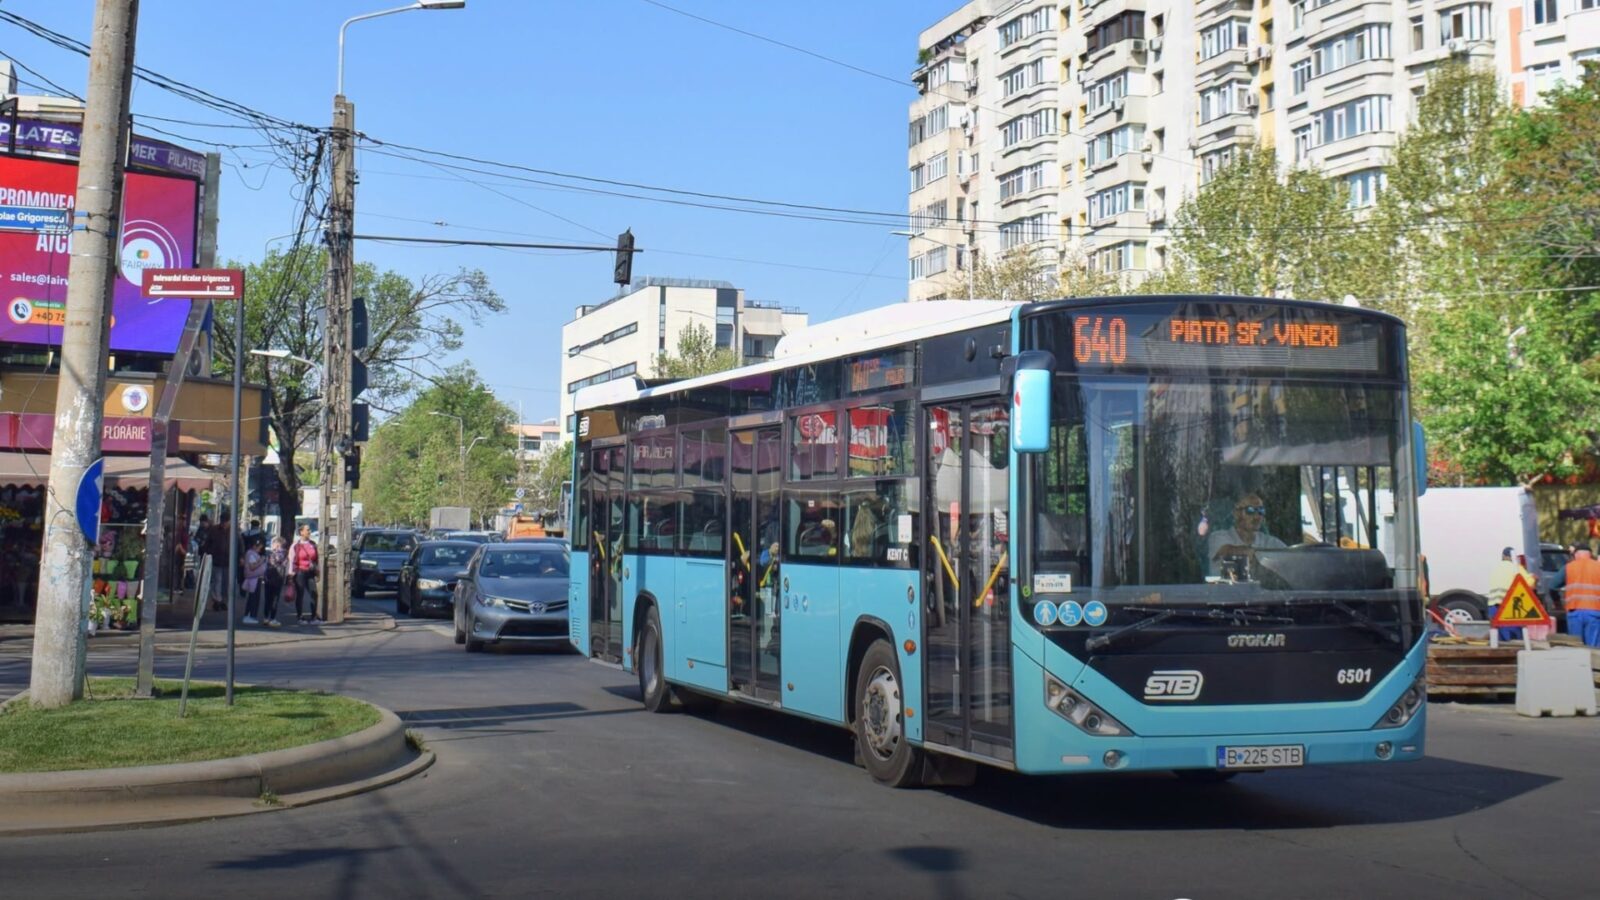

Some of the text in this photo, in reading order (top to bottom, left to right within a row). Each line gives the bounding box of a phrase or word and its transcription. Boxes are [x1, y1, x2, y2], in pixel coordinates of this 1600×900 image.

[0, 122, 74, 145] PLATES
[17, 212, 65, 223] Grigorescu
[1073, 316, 1127, 364] 640
[1170, 319, 1339, 348] PIATA SF. VINERI
[887, 548, 902, 561] KENT
[1227, 633, 1286, 648] OTOKAR
[1144, 674, 1199, 696] STB
[1337, 668, 1372, 685] 6501
[1227, 747, 1300, 765] B 225 STB
